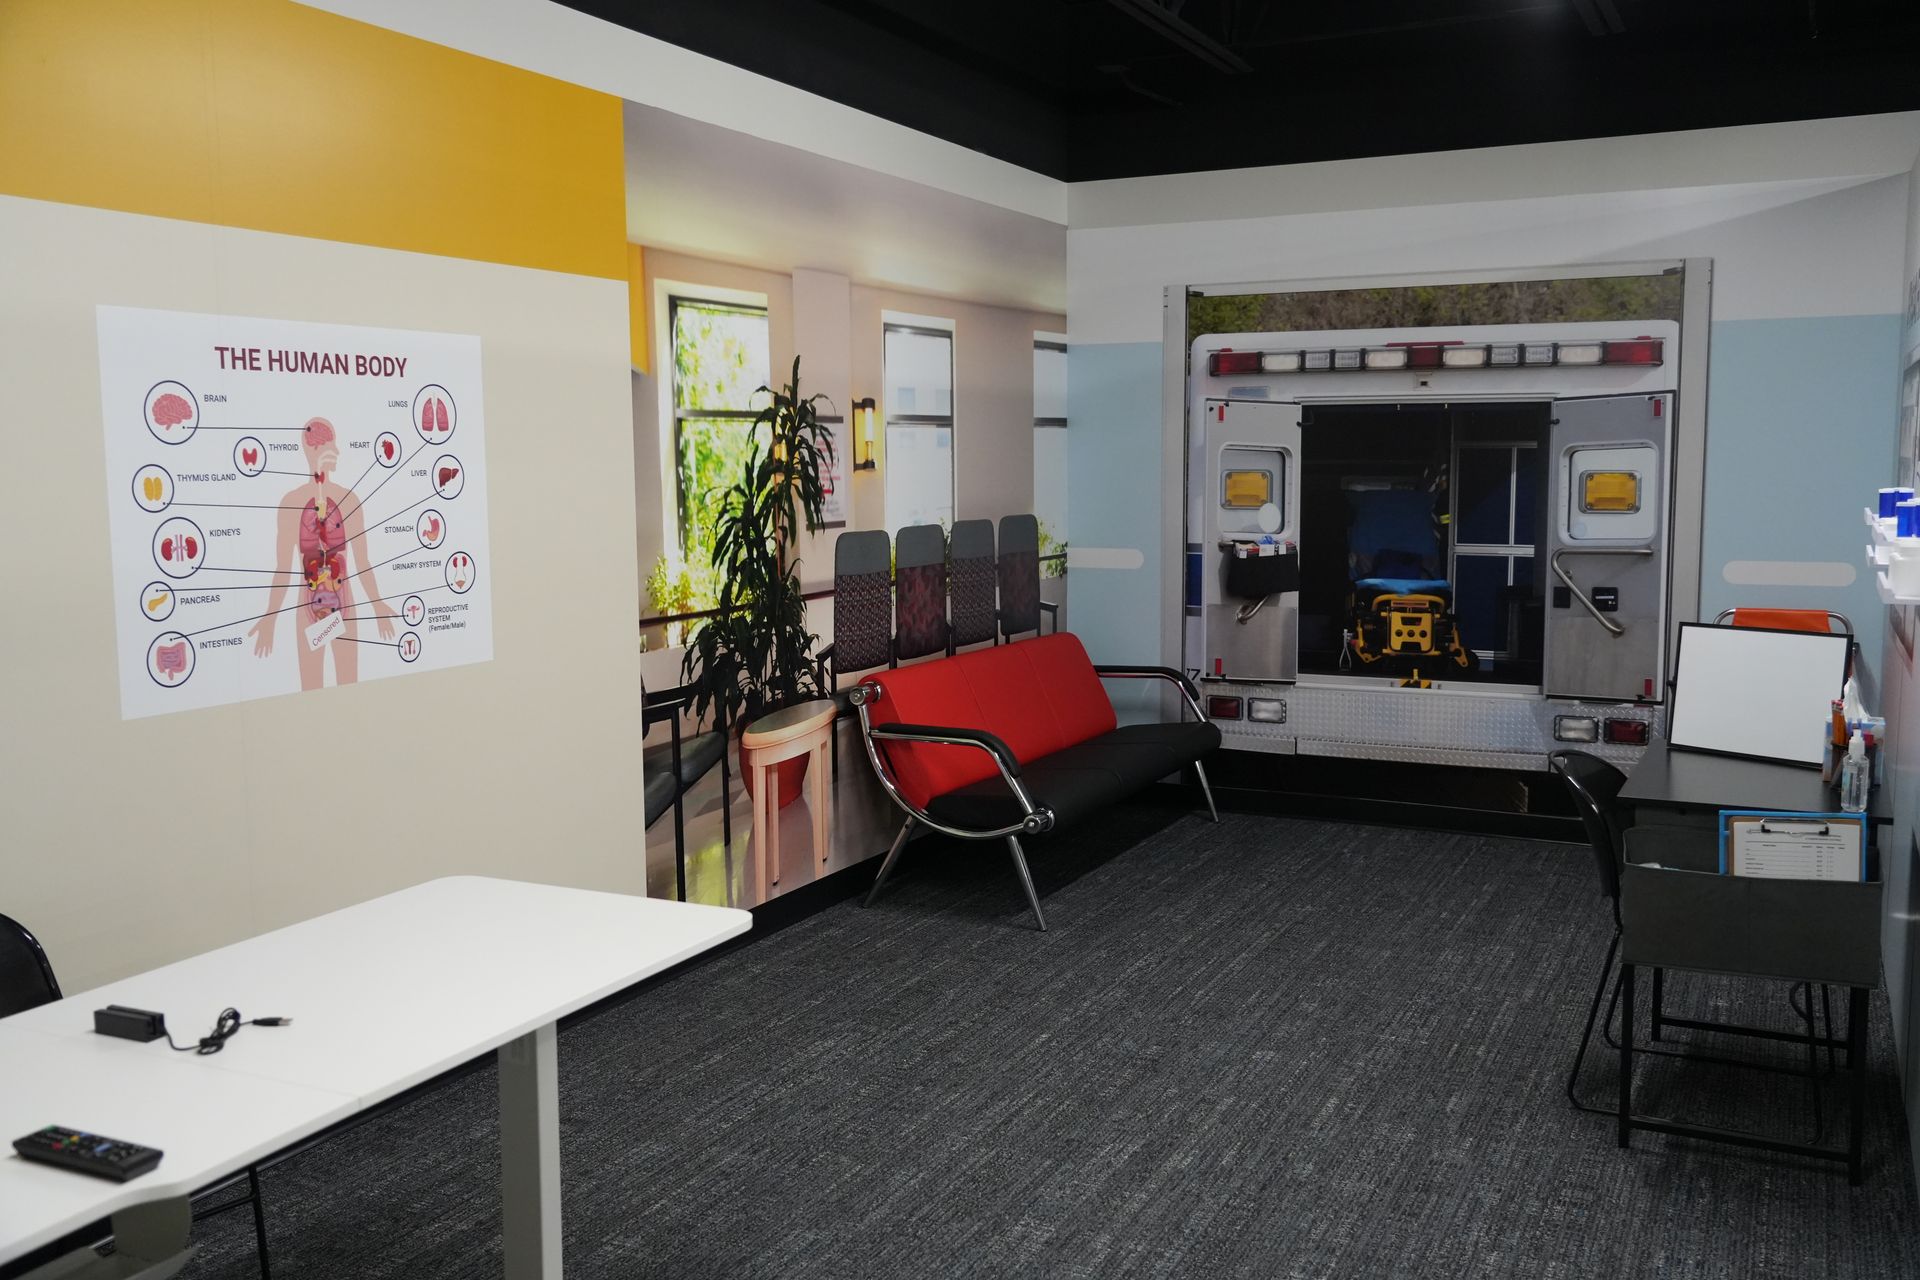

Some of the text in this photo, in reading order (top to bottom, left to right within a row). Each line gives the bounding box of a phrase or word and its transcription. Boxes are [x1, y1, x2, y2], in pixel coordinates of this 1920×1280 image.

[215, 346, 408, 377] THE HUMAN BODY
[204, 394, 227, 402] BRAIN
[388, 400, 408, 408] LUNGS
[269, 443, 299, 451] THYROID
[349, 441, 370, 449] HEART
[177, 473, 237, 482] THYMUS GLAND
[209, 528, 241, 537] KIDNEYS
[384, 525, 414, 534] STOMACH
[392, 560, 442, 571] URINARY SYSTEM
[180, 594, 221, 606] PANCREAS
[428, 603, 469, 615] REPRODUCTIVE
[428, 614, 451, 624] SYSTEM
[312, 617, 341, 647] Censored
[428, 621, 467, 633] (Female/Male)
[199, 637, 243, 649] INTESTINES
